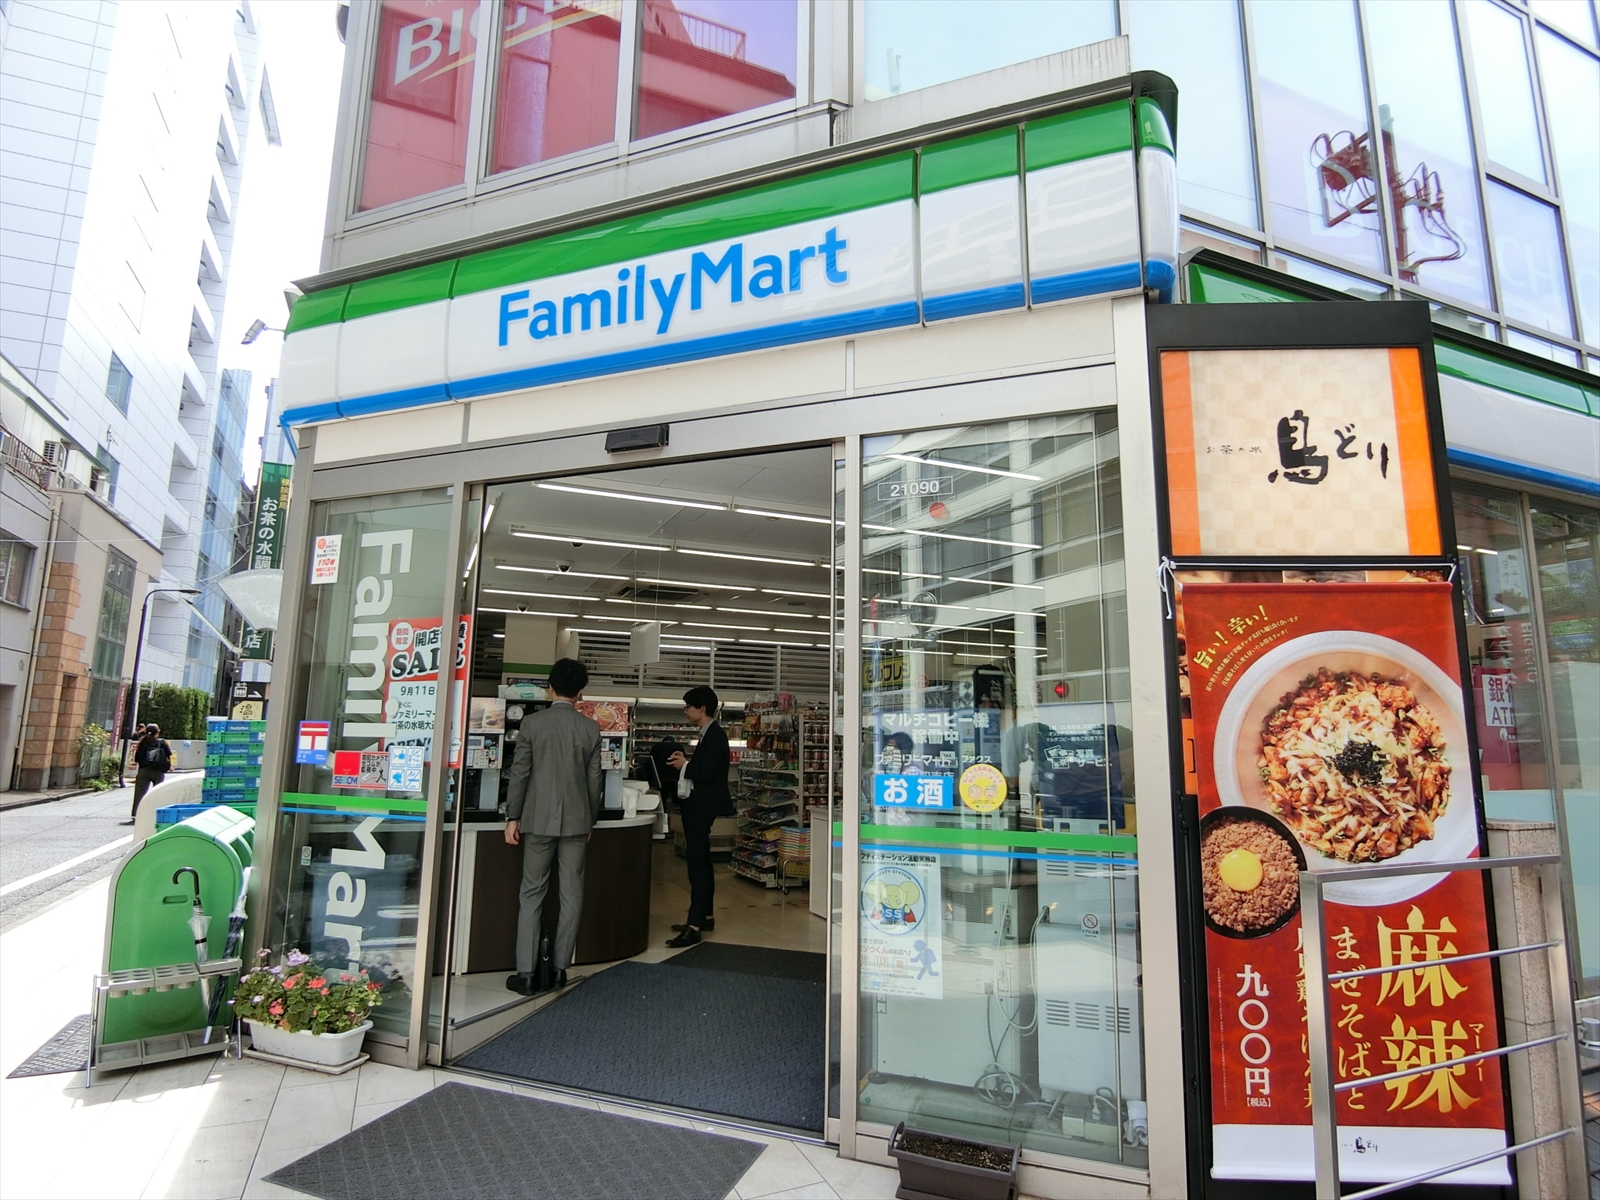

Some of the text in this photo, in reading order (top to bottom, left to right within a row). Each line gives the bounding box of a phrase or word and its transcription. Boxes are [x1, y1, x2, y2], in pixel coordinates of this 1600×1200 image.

[498, 226, 849, 347] FamilyMart
[890, 480, 940, 497] 21090
[883, 711, 990, 728] マルチコピー機
[911, 728, 959, 745] 稼働中
[883, 777, 944, 807] お酒
[1376, 903, 1481, 1113] 麻辣
